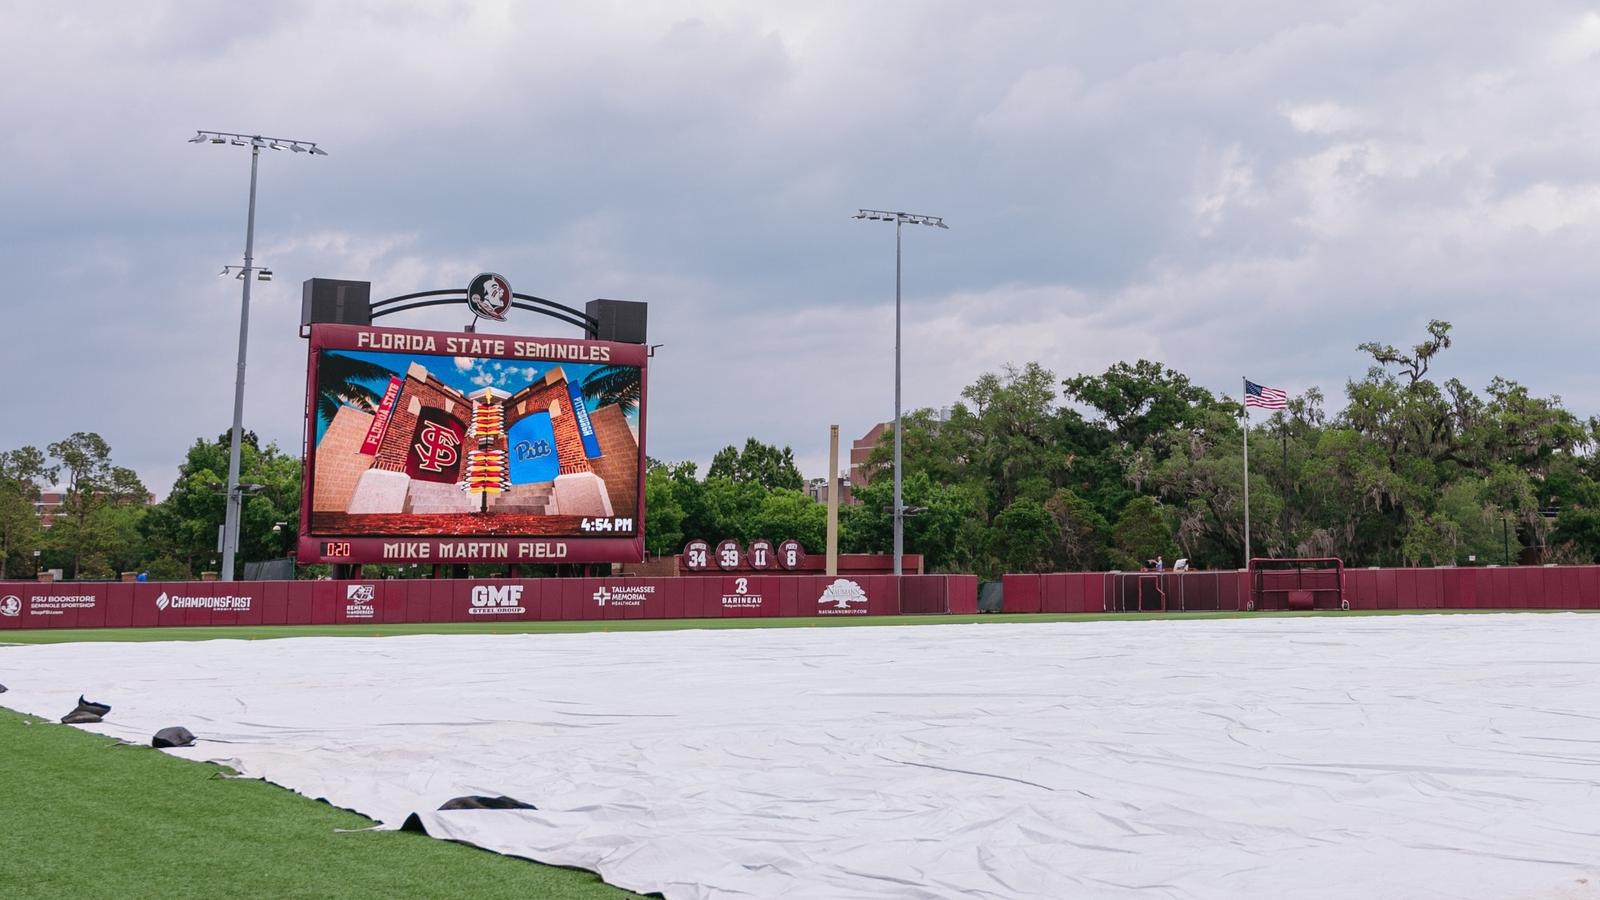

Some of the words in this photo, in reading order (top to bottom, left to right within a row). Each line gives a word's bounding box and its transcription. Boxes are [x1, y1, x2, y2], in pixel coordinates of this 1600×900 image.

[358, 332, 436, 351] FLORIDA
[447, 337, 505, 355] STATE
[514, 342, 610, 362] SEMINOLES
[366, 409, 390, 445] FLORIDA
[384, 382, 400, 409] STATE
[573, 396, 593, 437] PITTSBURGH
[514, 439, 552, 461] Pitt
[581, 518, 612, 531] 4:54
[614, 518, 633, 531] PM
[327, 542, 350, 557] 0:20
[383, 542, 430, 558] MIKE
[438, 542, 508, 558] MARTIN
[518, 542, 567, 558] FIELD
[754, 550, 767, 566] 11
[688, 550, 707, 567] 34
[720, 550, 739, 567] 39
[786, 550, 797, 567] 8
[735, 577, 748, 594] B
[31, 595, 47, 603] FSU
[48, 595, 96, 603] BOOKSTORE
[471, 585, 524, 606] GMF
[611, 593, 647, 601] MEMORIAL
